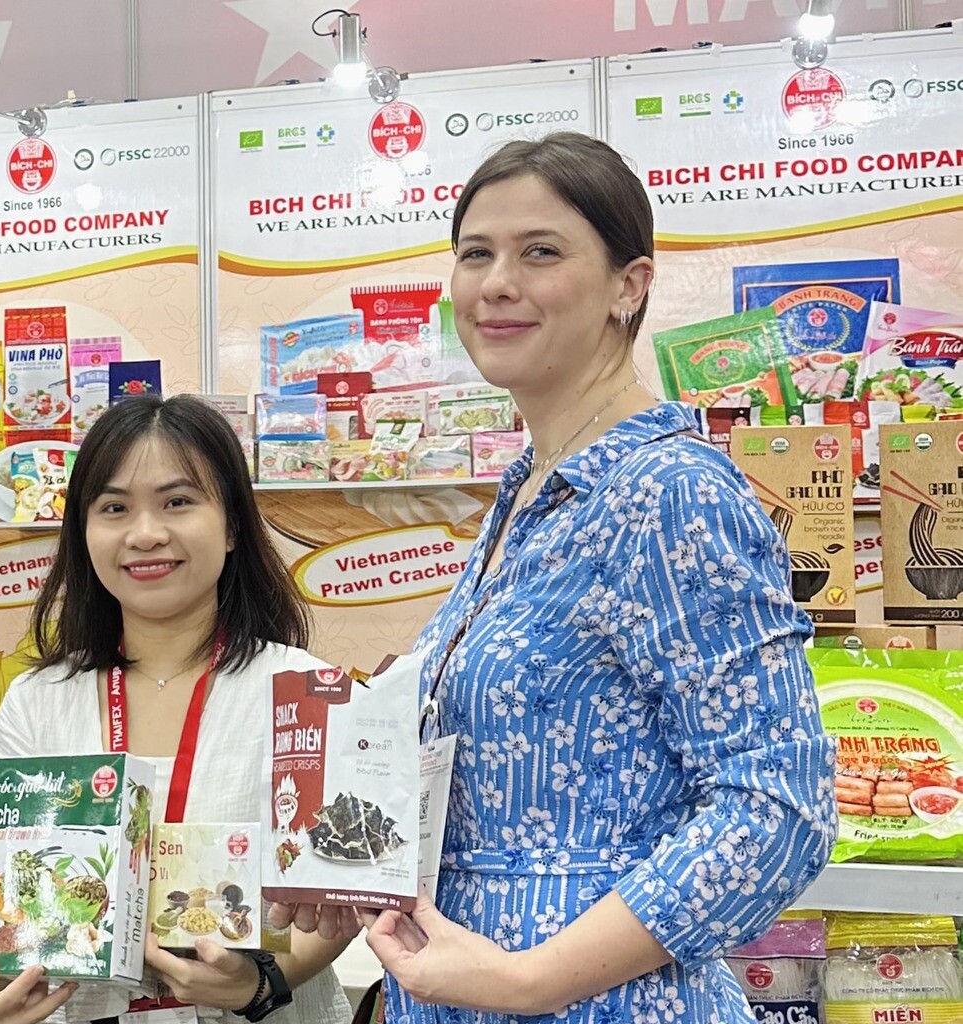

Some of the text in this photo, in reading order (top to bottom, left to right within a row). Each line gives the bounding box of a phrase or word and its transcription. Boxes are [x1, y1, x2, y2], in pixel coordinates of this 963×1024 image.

[497, 109, 579, 126] FSSC 22000
[778, 133, 854, 150] Since 1966
[118, 145, 190, 162] FSSC 22000
[648, 157, 847, 187] BICH CHI FOOD
[3, 197, 62, 212] Since 1966
[249, 192, 352, 216] BICH CHI
[657, 188, 749, 204] WE ARE
[1, 218, 56, 237] FOOD
[64, 209, 169, 233] COMPANY
[257, 221, 289, 233] WE
[295, 217, 337, 231] ARE
[8, 348, 35, 362] VINA
[887, 336, 933, 357] Bánh
[336, 540, 455, 572] Vietnamese
[320, 576, 383, 598] Prawn
[941, 610, 960, 619] 200
[111, 705, 123, 750] THAIFEX
[358, 739, 393, 751] Korean
[294, 759, 321, 771] CRISPS
[159, 840, 183, 855] Sen
